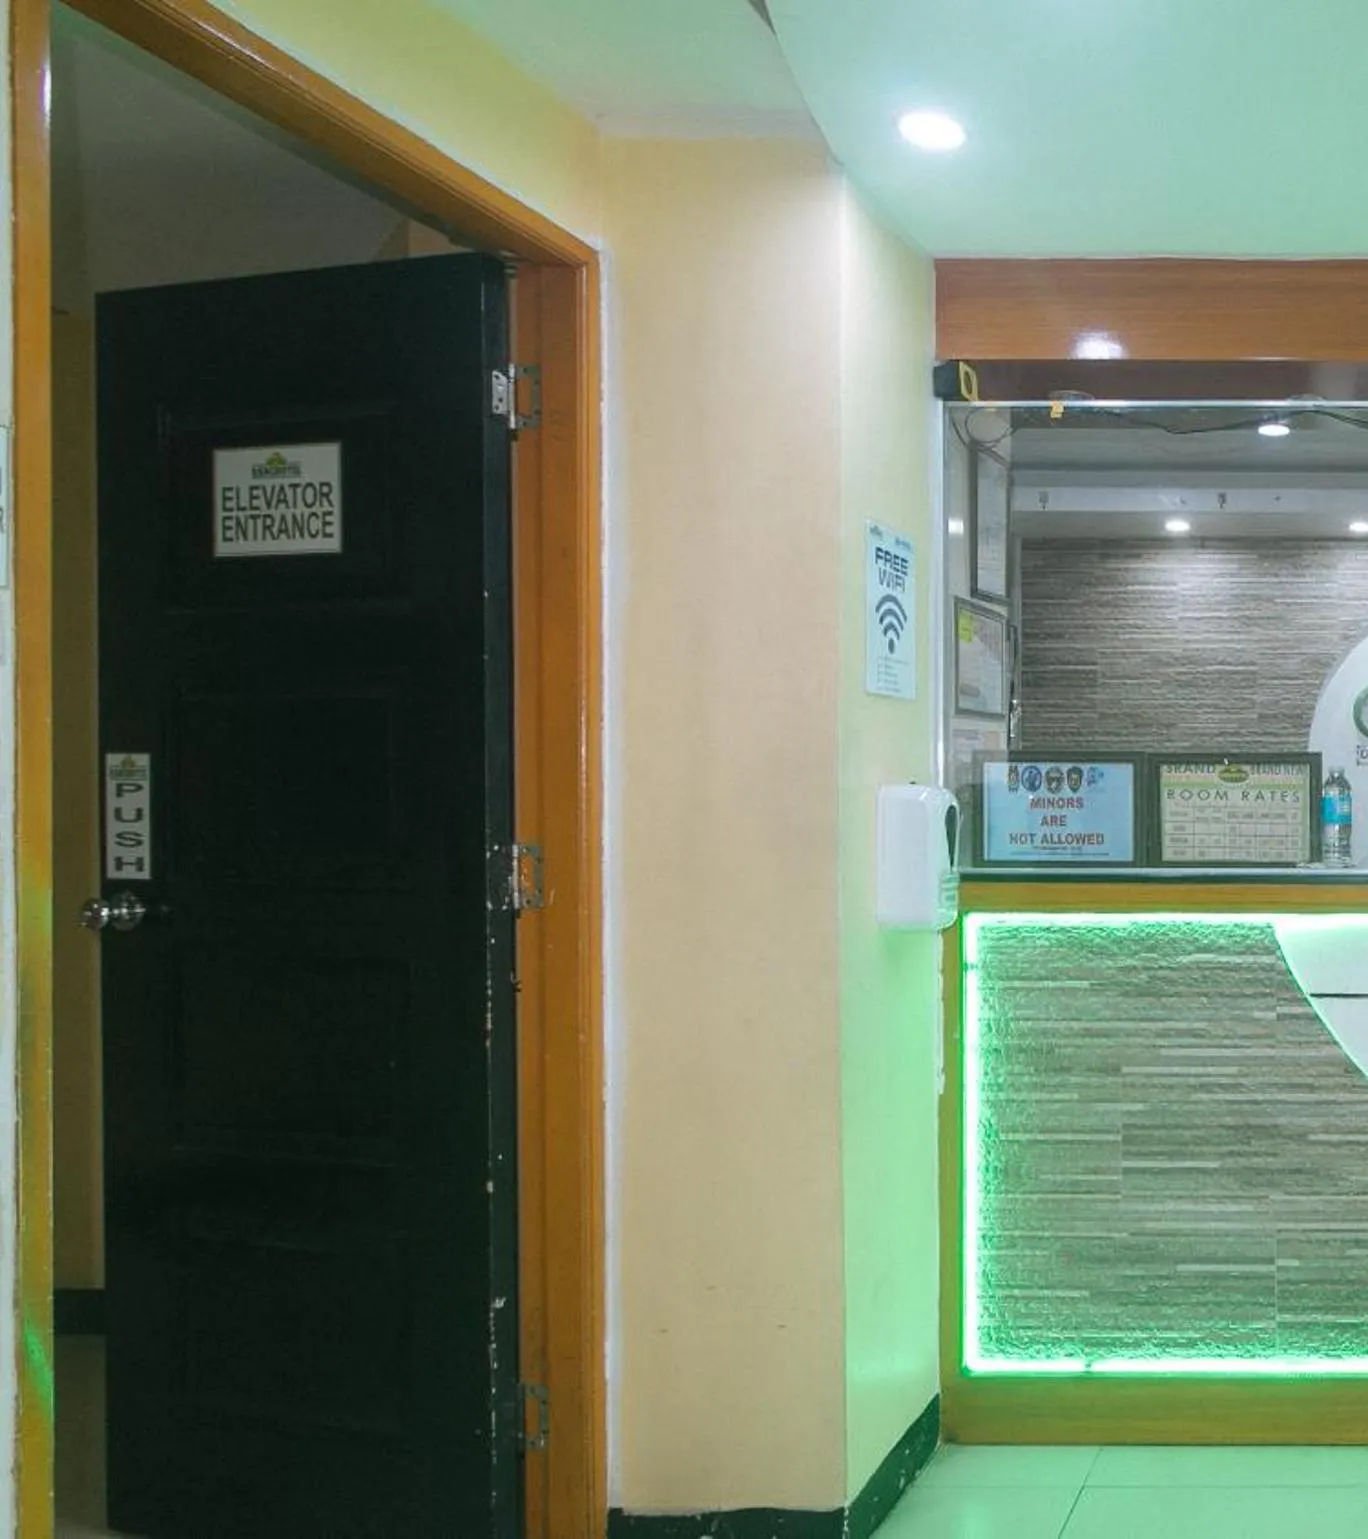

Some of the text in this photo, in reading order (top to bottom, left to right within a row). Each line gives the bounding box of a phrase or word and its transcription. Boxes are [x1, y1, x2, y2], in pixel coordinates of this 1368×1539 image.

[221, 481, 335, 513] ELEVATOR
[221, 510, 335, 542] ENTRANCE
[875, 546, 909, 577] FREE
[1030, 796, 1085, 810] MINORS
[1166, 788, 1300, 803] ROOM RATES
[113, 782, 145, 873] PUSH
[1040, 814, 1068, 827] ARE
[1009, 832, 1105, 845] NOT ALLOWED
